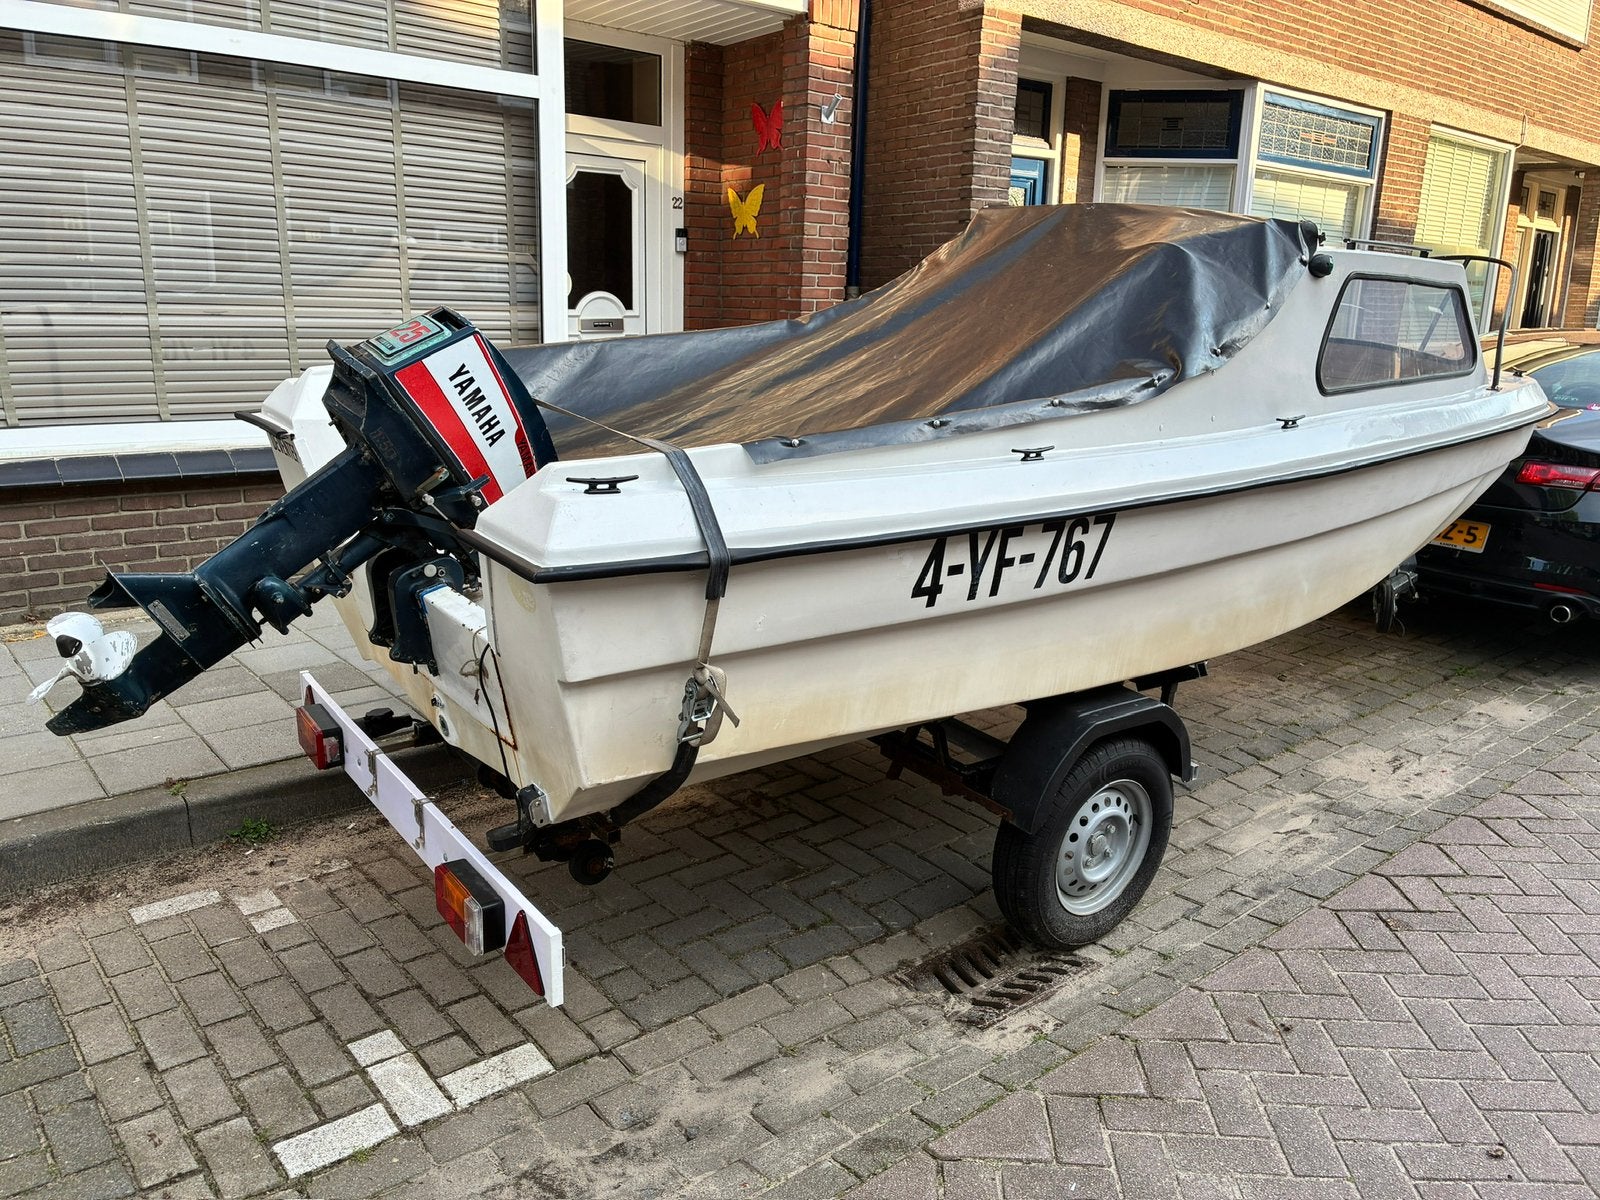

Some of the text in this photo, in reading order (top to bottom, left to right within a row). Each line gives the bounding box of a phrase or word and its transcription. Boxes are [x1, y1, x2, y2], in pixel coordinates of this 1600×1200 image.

[672, 196, 683, 210] 22
[390, 320, 432, 344] 25
[448, 362, 506, 448] YAMAHA
[1436, 522, 1479, 544] Z-5
[910, 512, 1117, 609] 4-YF-767
